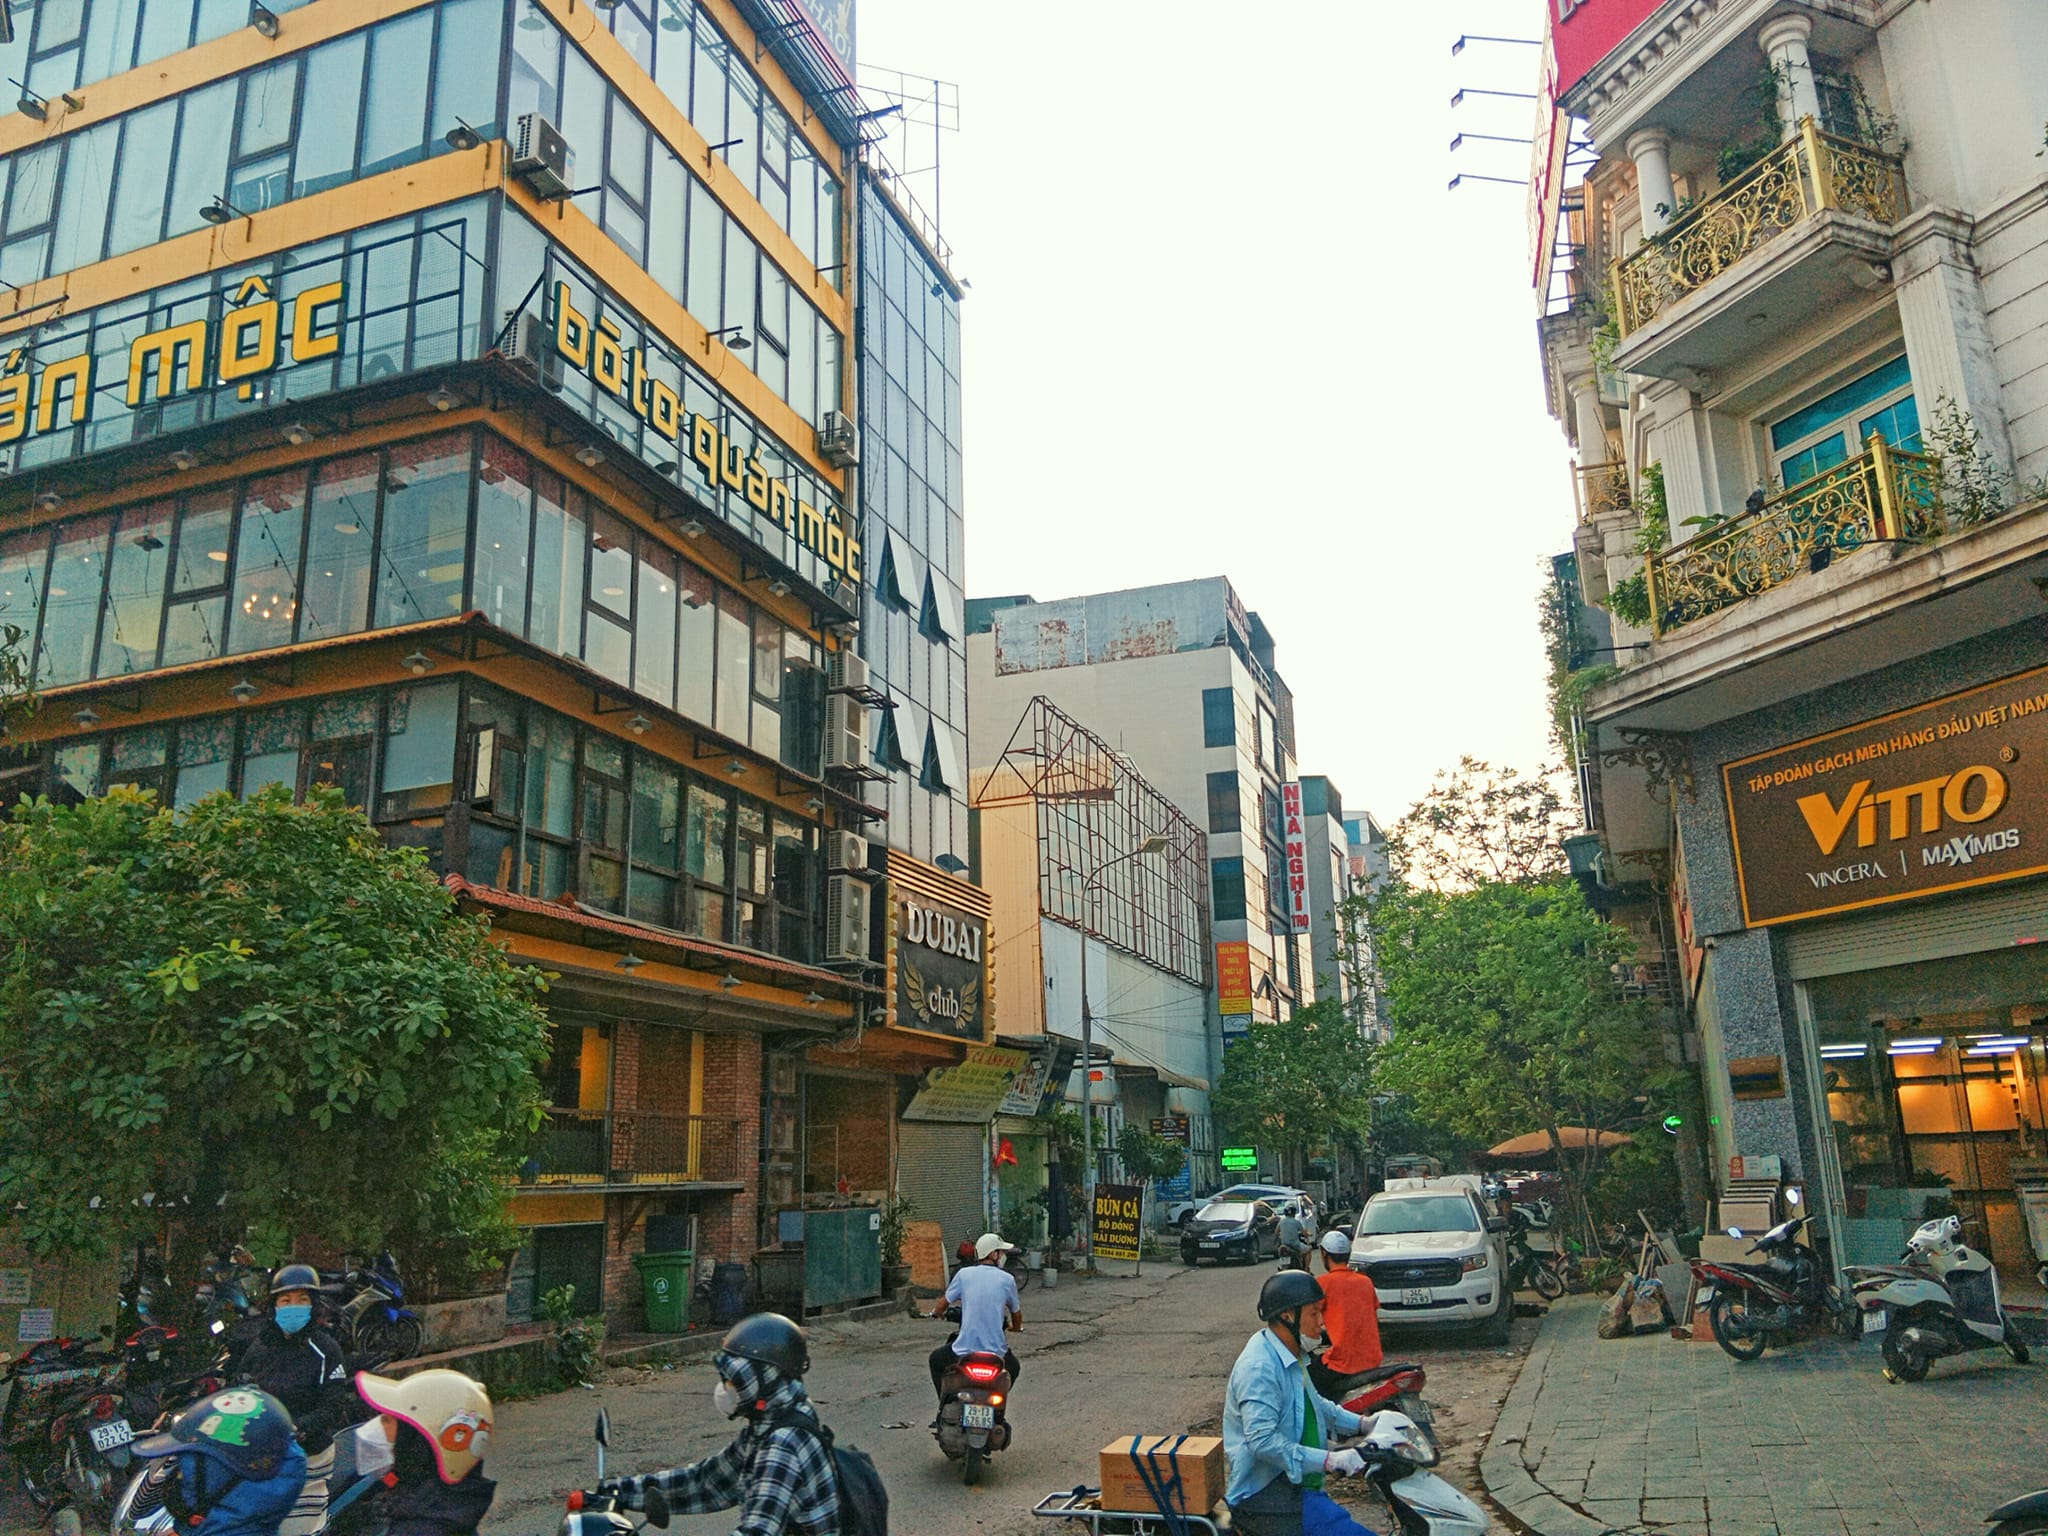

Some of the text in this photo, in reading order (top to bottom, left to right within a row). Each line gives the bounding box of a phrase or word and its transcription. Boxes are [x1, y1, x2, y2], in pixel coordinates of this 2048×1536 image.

[127, 275, 346, 407] mộc
[694, 412, 791, 530] quán
[798, 500, 862, 585] mộc
[1748, 775, 1772, 795] TẬP
[1774, 763, 1813, 786] ĐOÀN
[1815, 751, 1854, 775] GẠCH
[1856, 743, 1889, 763] MEN
[1890, 727, 1935, 752] HÀNG
[1937, 713, 1972, 739] ĐẦU
[1973, 705, 2008, 729] VIỆT
[1283, 785, 1305, 912] NHÀ NGHỈ
[1922, 828, 2021, 867] MAXIMOS
[1805, 861, 1889, 889] VINCERA
[907, 900, 982, 963] DUBAI
[1291, 914, 1309, 930] TRỌ
[929, 984, 959, 1019] club
[1096, 1194, 1139, 1219] BÚN CÁ
[1109, 1232, 1138, 1246] DƯƠNG
[97, 1422, 125, 1439] 29-Y5
